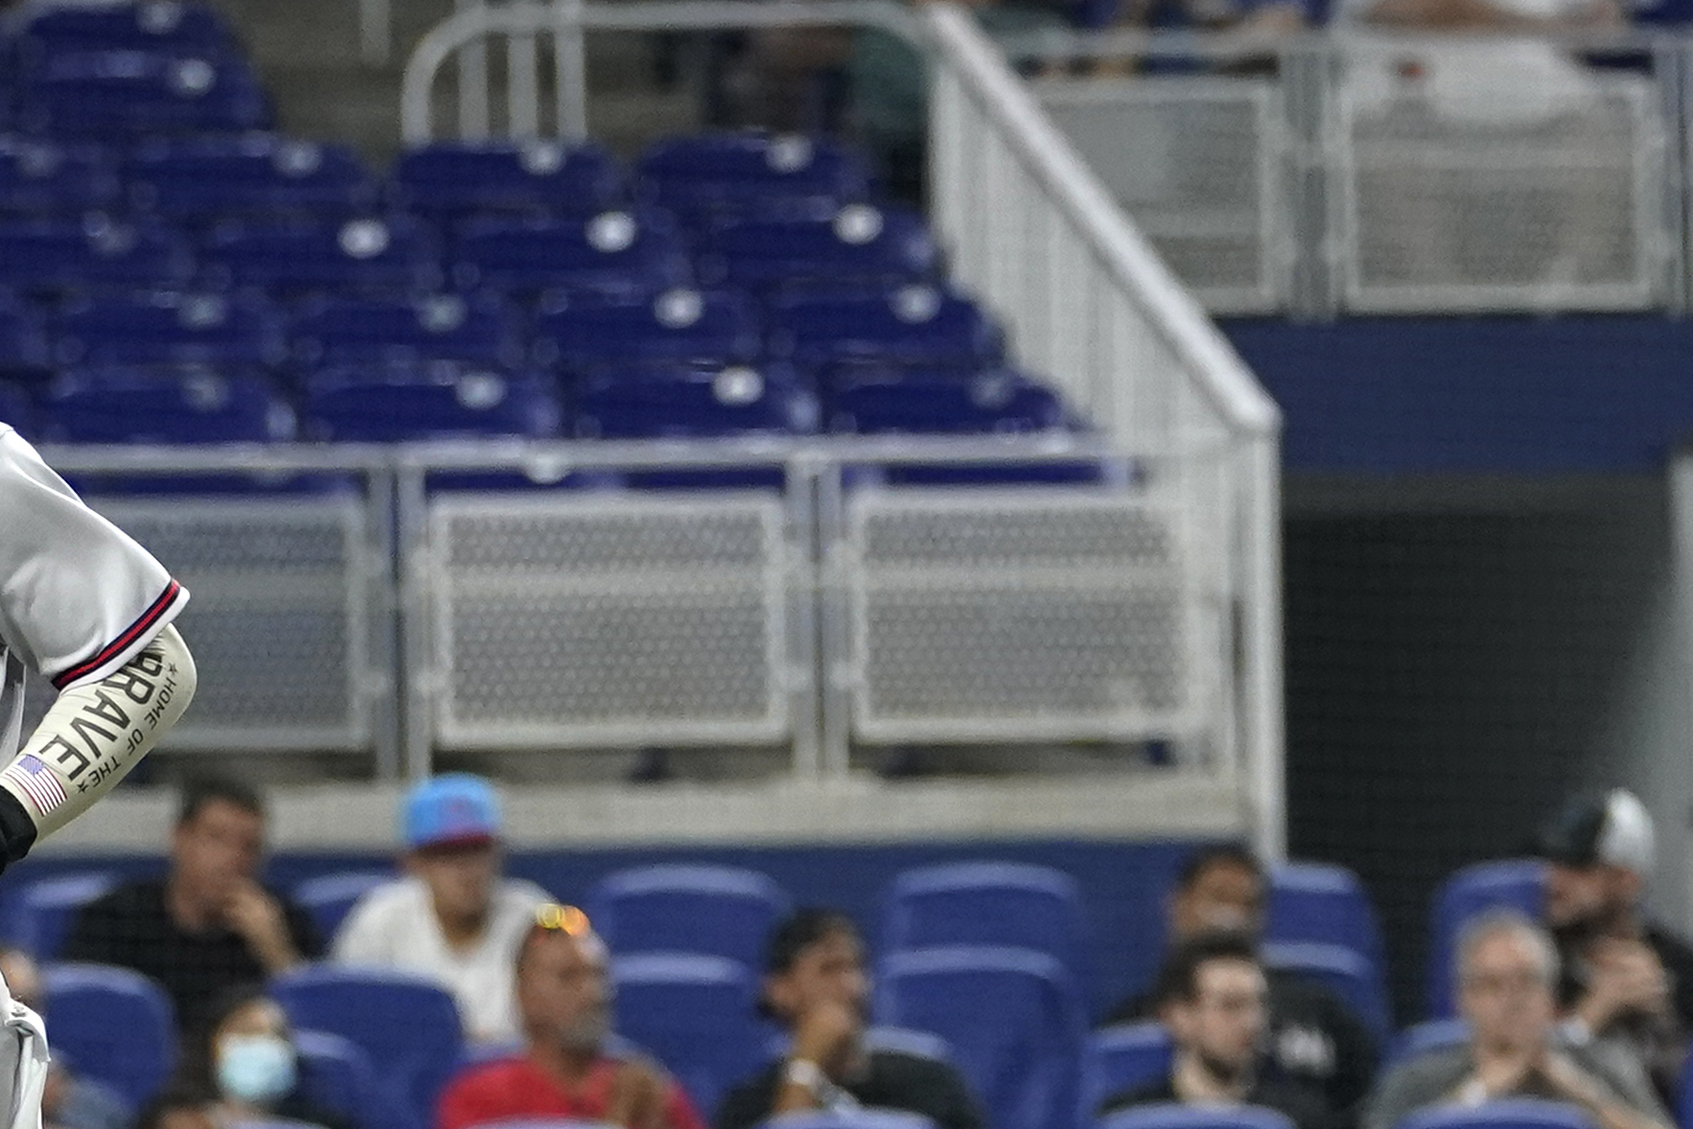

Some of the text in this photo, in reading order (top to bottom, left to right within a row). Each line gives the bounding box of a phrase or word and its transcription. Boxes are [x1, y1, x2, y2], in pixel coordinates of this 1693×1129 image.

[38, 649, 165, 783] BRAVE
[88, 675, 178, 789] HOME OF THE
